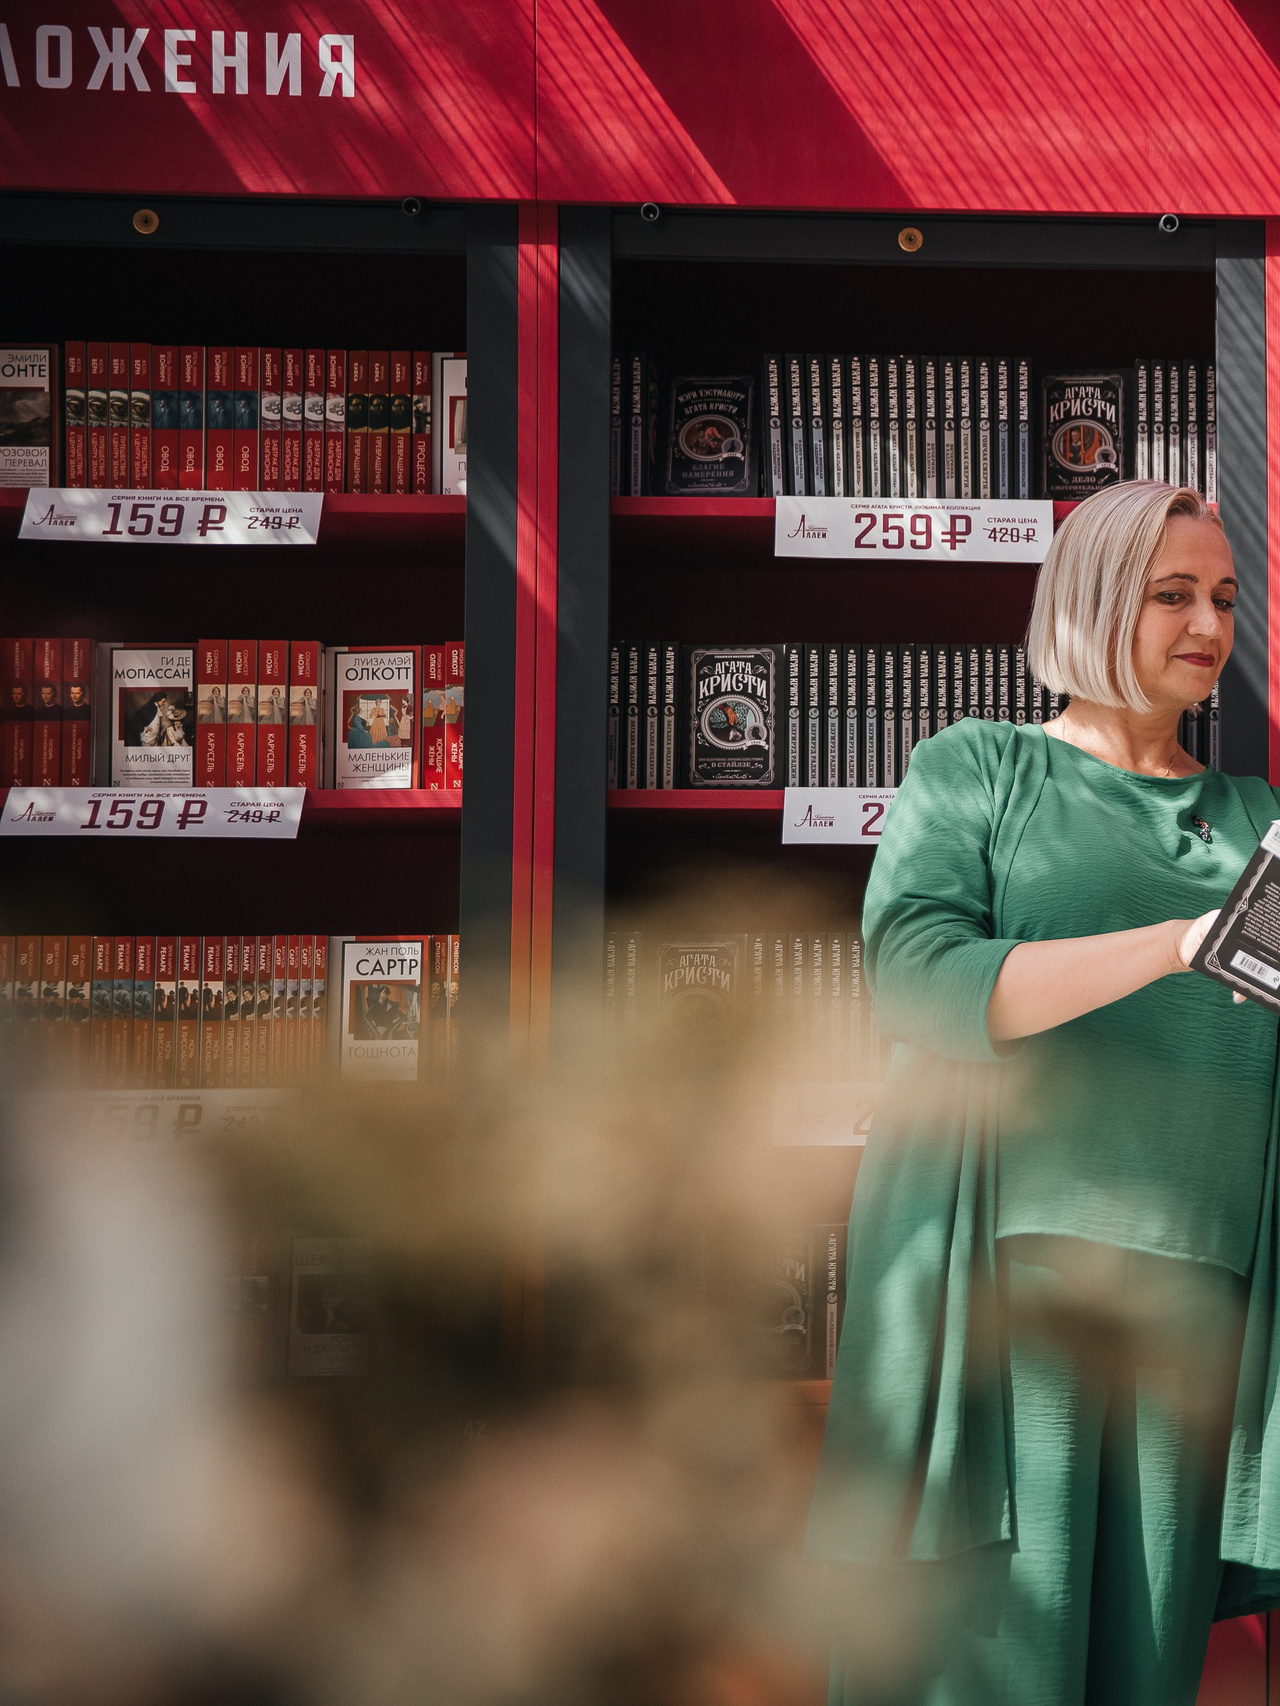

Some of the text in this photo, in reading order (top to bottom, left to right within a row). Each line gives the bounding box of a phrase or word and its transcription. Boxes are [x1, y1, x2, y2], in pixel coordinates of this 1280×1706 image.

[8, 354, 46, 362] ЭМИЛИ
[0, 364, 46, 378] ОНТЕ
[1064, 386, 1101, 400] АГАТА
[684, 403, 738, 415] АГАТА КРИСТИ
[1050, 398, 1116, 422] КРИСТИ
[5, 459, 46, 467] ПЕРЕВАЛ
[161, 446, 170, 472] ОВОД
[416, 440, 426, 484] ПРОЦЕСС
[682, 470, 734, 478] НАМЕРЕНИЯ
[102, 503, 185, 536] 159
[854, 513, 932, 550] 259
[161, 657, 190, 667] ГИ ДЕ
[353, 656, 410, 667] ЛУИЗА МЭЙ
[715, 661, 752, 676] АГАТА
[114, 668, 190, 679] МОПАССАН
[345, 667, 411, 681] ОЛКОТТ
[699, 674, 767, 699] КРИСТИ
[125, 752, 190, 764] МИЛЫЙ ДРУГ
[207, 732, 215, 773] КАРУСЕЛЬ
[348, 752, 410, 762] МАЛЕНЬКИЕ
[352, 763, 409, 773] ЖЕНЩИНЫ
[80, 800, 166, 830] 159
[182, 945, 190, 971] РЕМАРК
[365, 947, 419, 956] ЖАН ПОЛЬ
[356, 959, 418, 976] САРТР
[680, 954, 716, 967] АГАТА
[664, 966, 730, 992] КРИСТИ
[348, 1046, 416, 1058] ТОШНОТА
